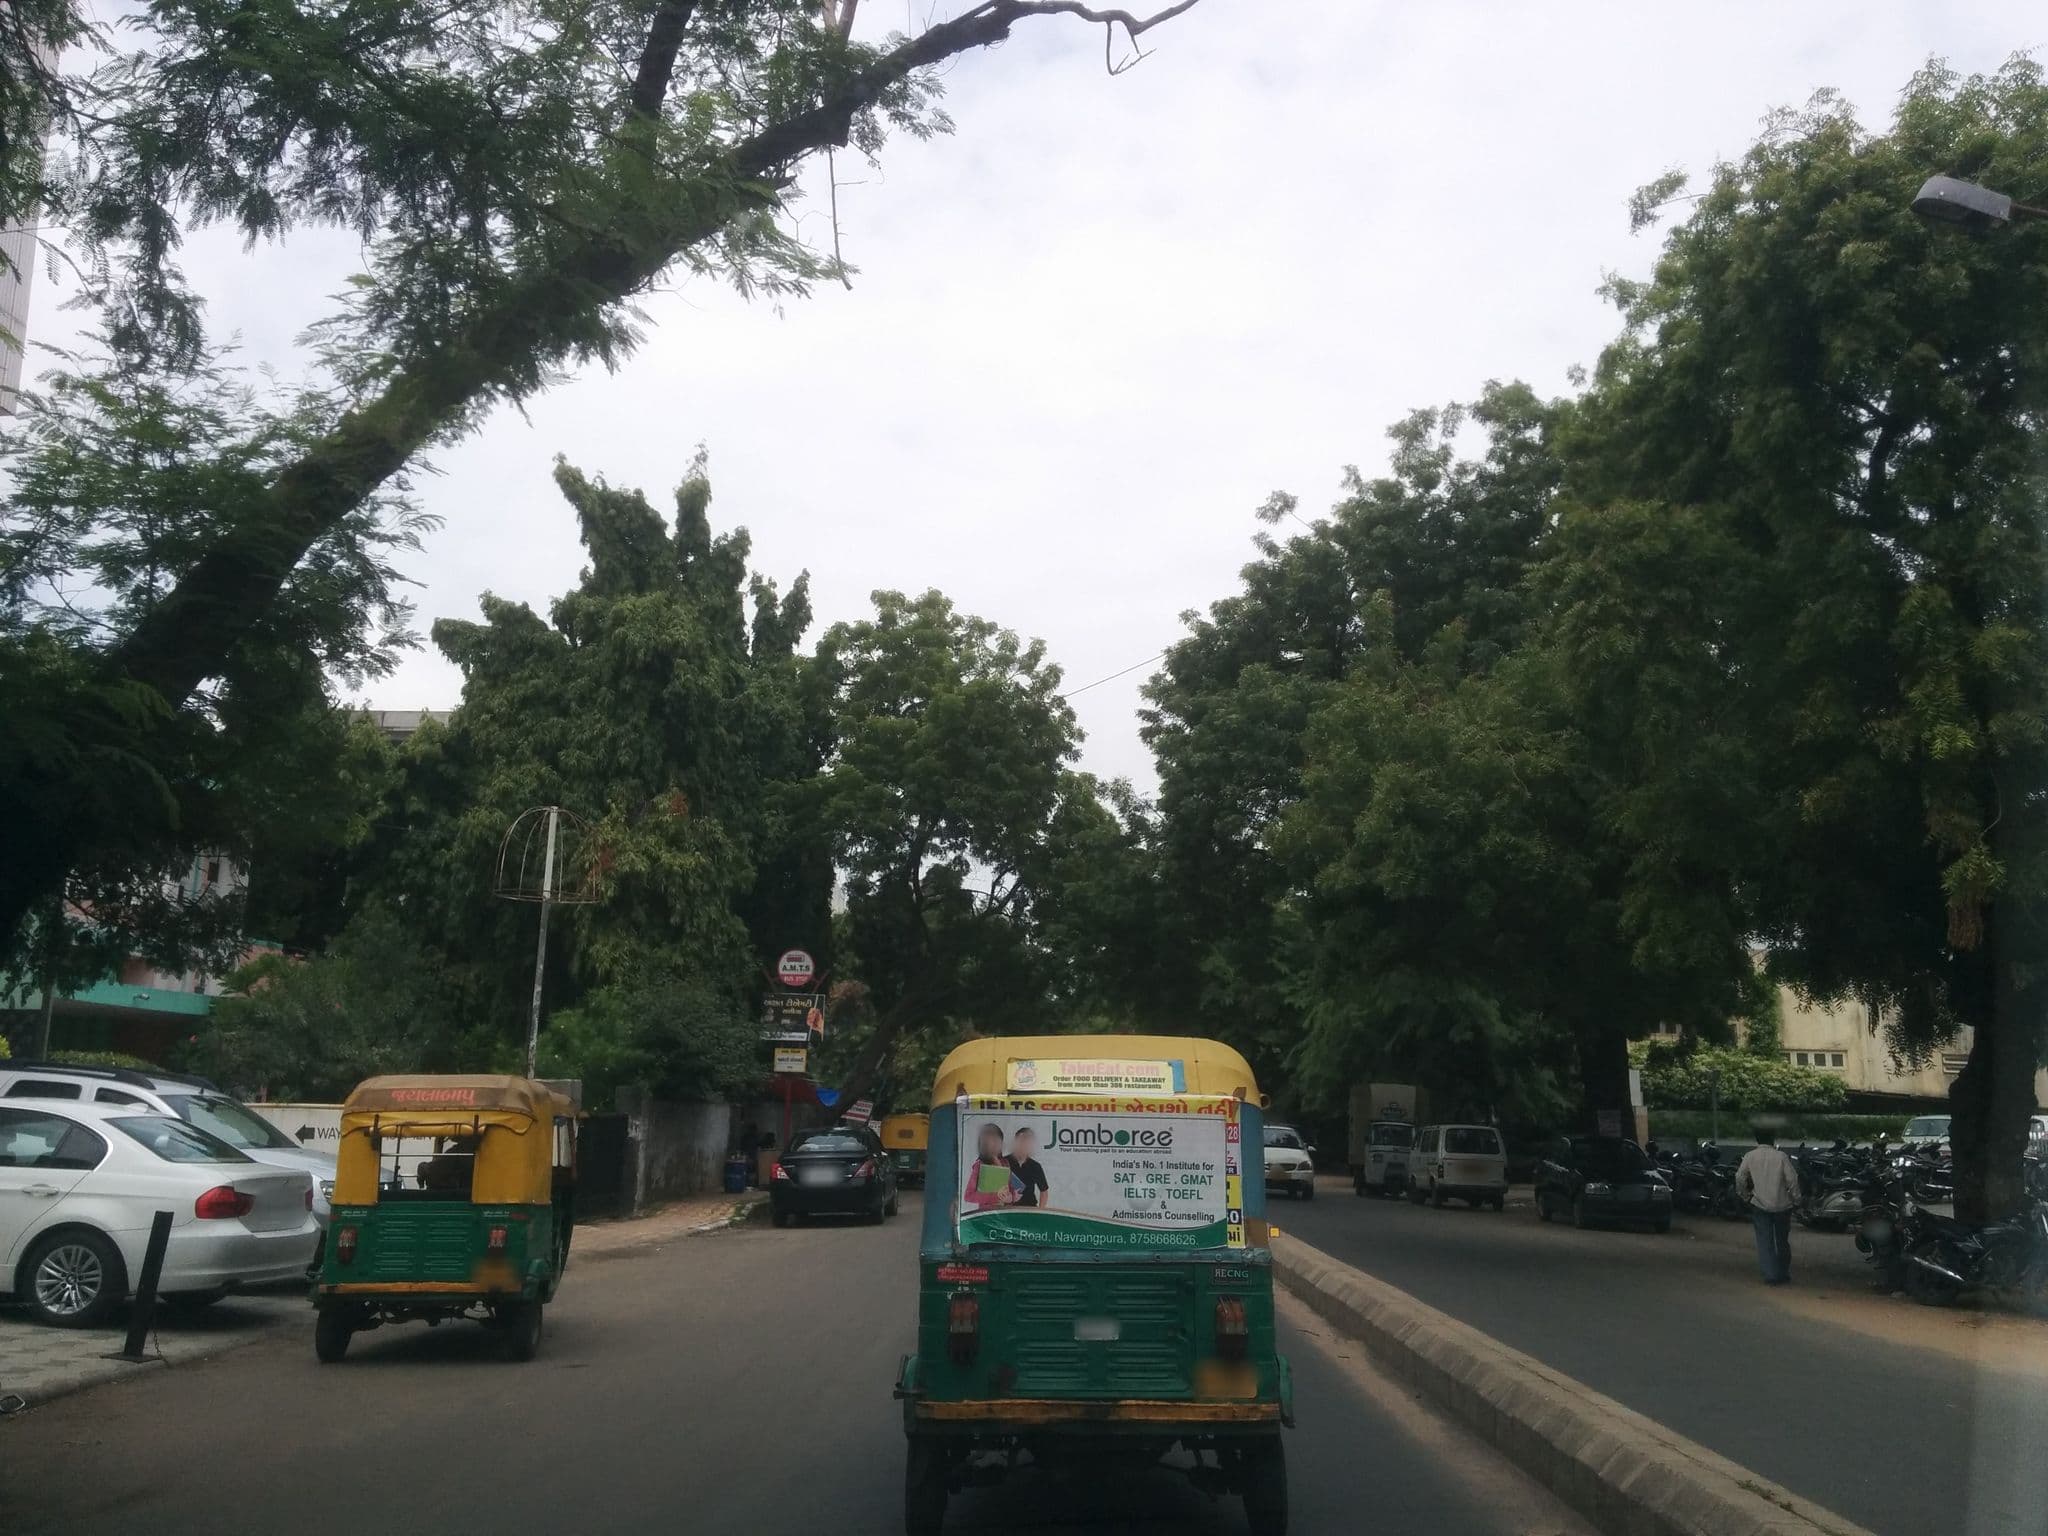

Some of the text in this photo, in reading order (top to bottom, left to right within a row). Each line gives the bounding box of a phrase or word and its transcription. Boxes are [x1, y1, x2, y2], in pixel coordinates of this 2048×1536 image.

[317, 1127, 341, 1139] WAY
[1044, 1120, 1173, 1149] Jamboree
[1112, 1160, 1140, 1169] India's
[1143, 1161, 1157, 1169] No.
[1166, 1161, 1200, 1170] Institute
[1202, 1162, 1214, 1171] for
[1114, 1172, 1214, 1185] SAT GRE GMAT
[1124, 1187, 1204, 1200] IELTS TOEFL
[1160, 1200, 1167, 1209] &
[1112, 1210, 1215, 1223] Admissions Counselling
